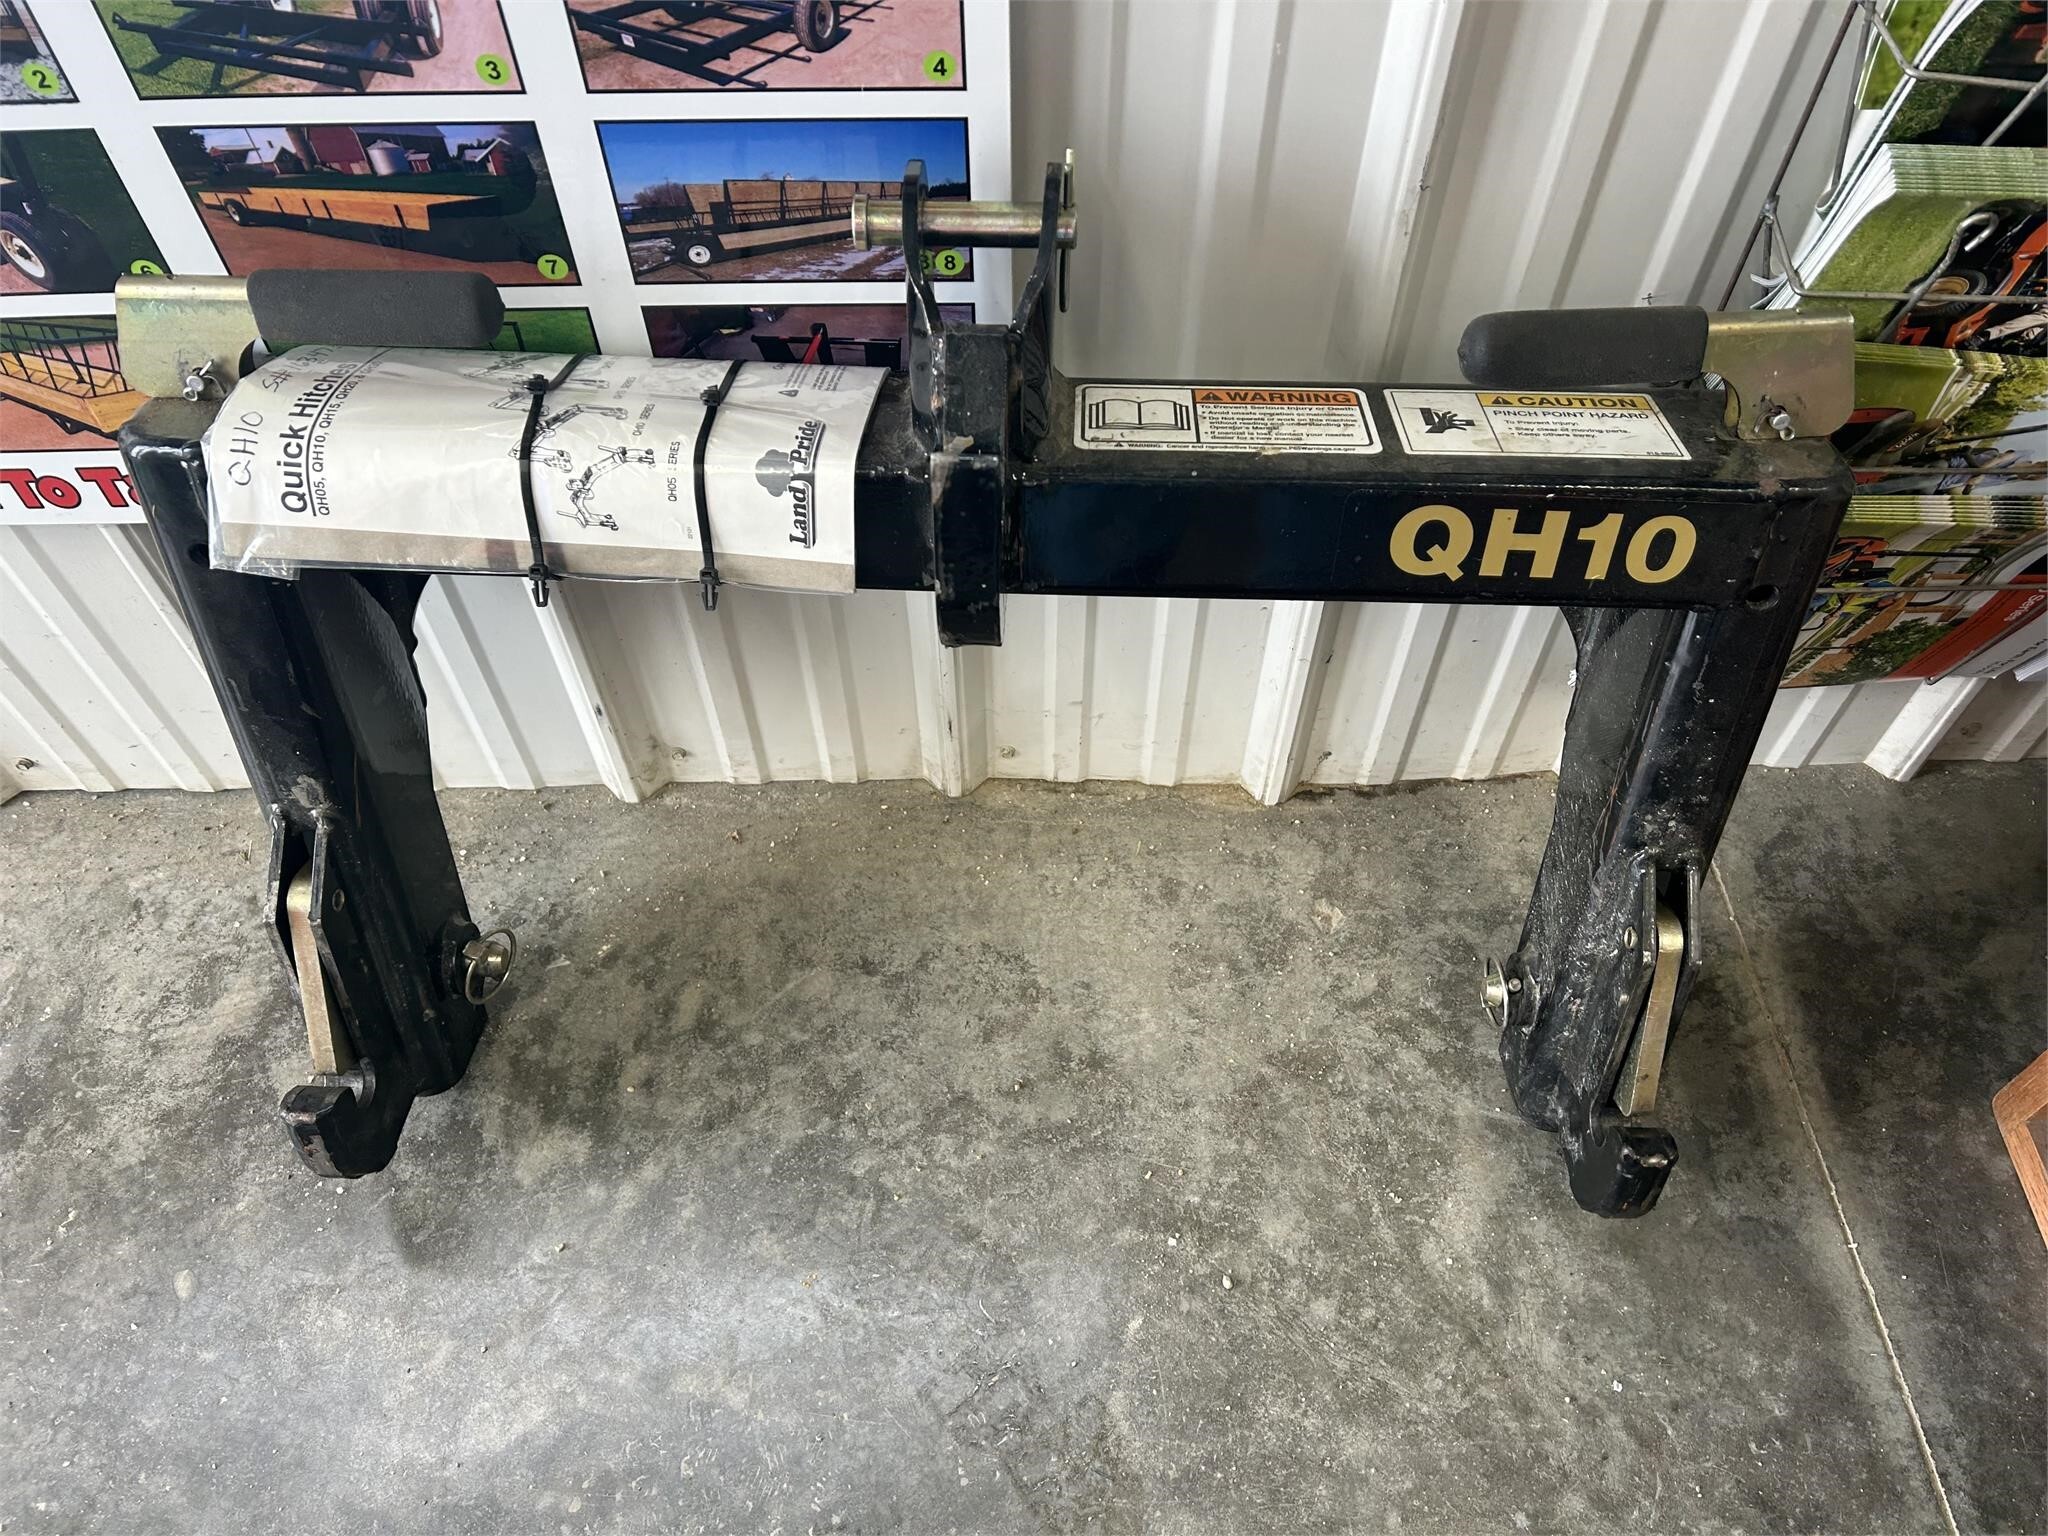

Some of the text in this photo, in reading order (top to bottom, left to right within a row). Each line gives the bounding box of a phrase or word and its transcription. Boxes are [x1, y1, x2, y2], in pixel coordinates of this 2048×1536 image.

[31, 70, 52, 89] 2
[484, 60, 502, 79] 3
[932, 57, 947, 76] 4
[545, 258, 557, 275] 7
[945, 255, 956, 270] 8
[1225, 391, 1351, 403] WARNING
[1517, 396, 1638, 408] CAUTION
[319, 401, 345, 429] QH15,
[1492, 409, 1650, 419] PINCH POINT HAZARD
[227, 411, 264, 486] QH10
[276, 362, 358, 513] Quick Hitches
[312, 431, 330, 473] QH10,
[668, 441, 681, 472] ERIES
[0, 468, 82, 510] To
[314, 477, 331, 516] QH05,
[788, 419, 818, 546] Land Pride
[1389, 504, 1697, 583] QH10
